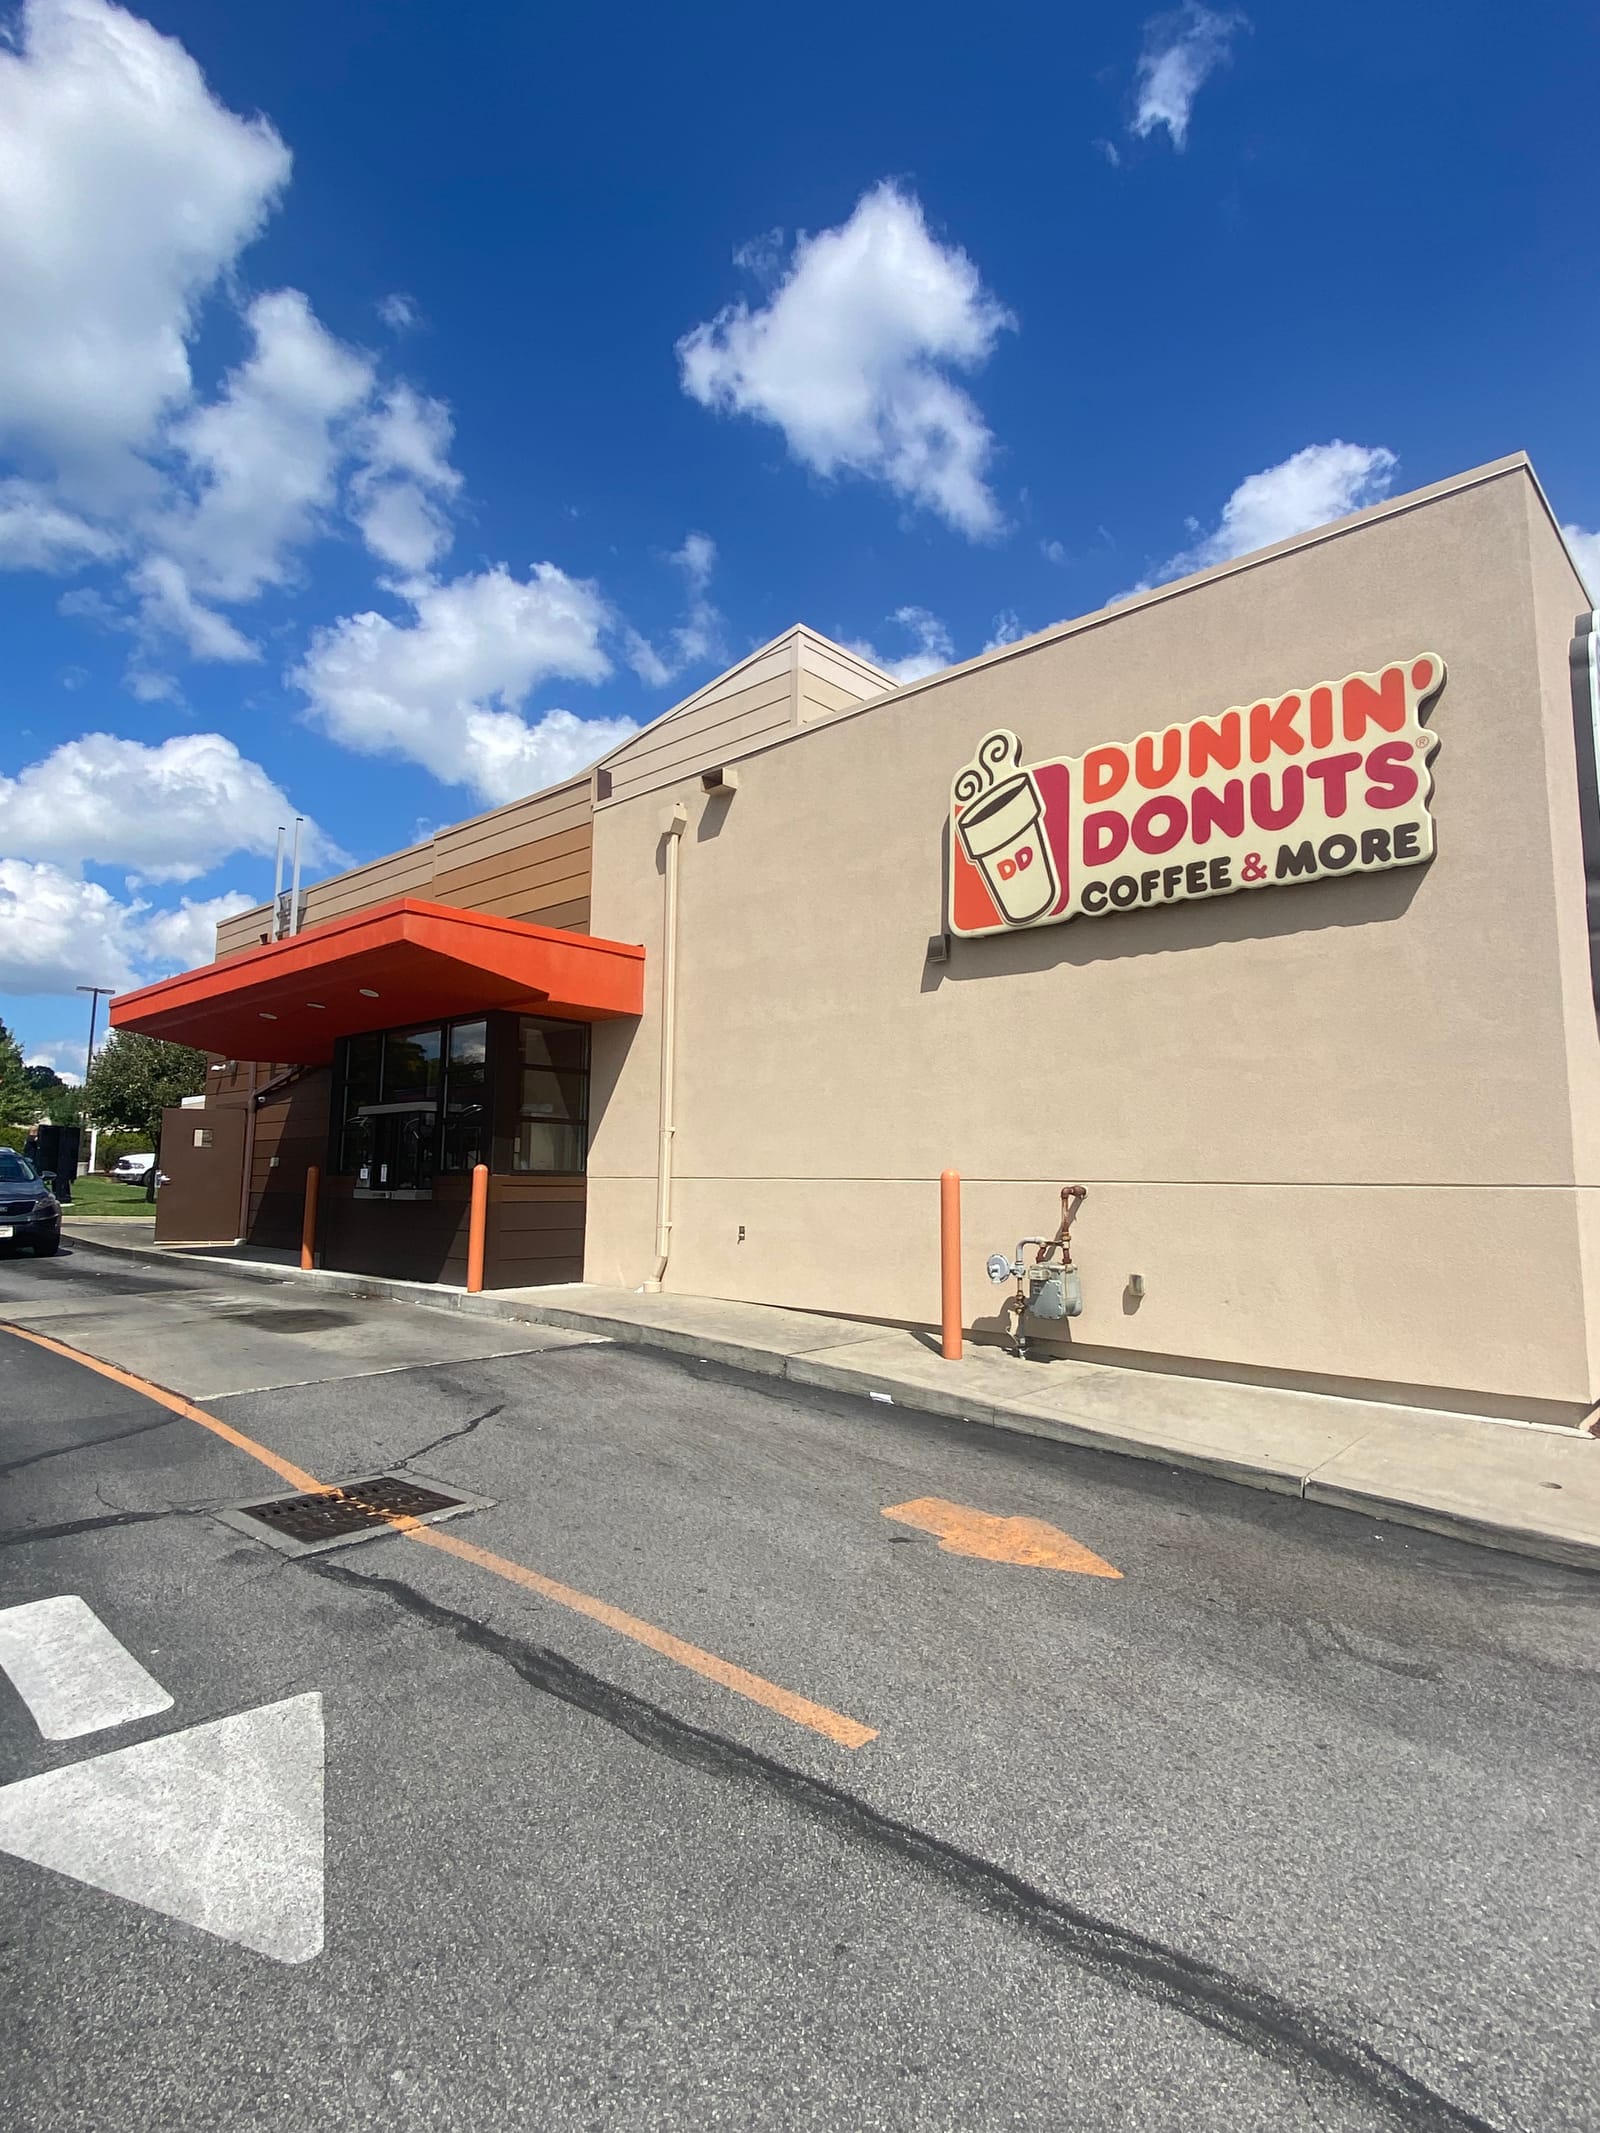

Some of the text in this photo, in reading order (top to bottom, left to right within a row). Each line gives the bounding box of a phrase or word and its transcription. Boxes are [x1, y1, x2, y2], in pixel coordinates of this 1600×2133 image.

[1083, 658, 1433, 804] DUNKIN'
[1083, 740, 1419, 867] DONUTS
[996, 846, 1033, 881] DD
[1081, 822, 1421, 912] COFFEE & MORE
